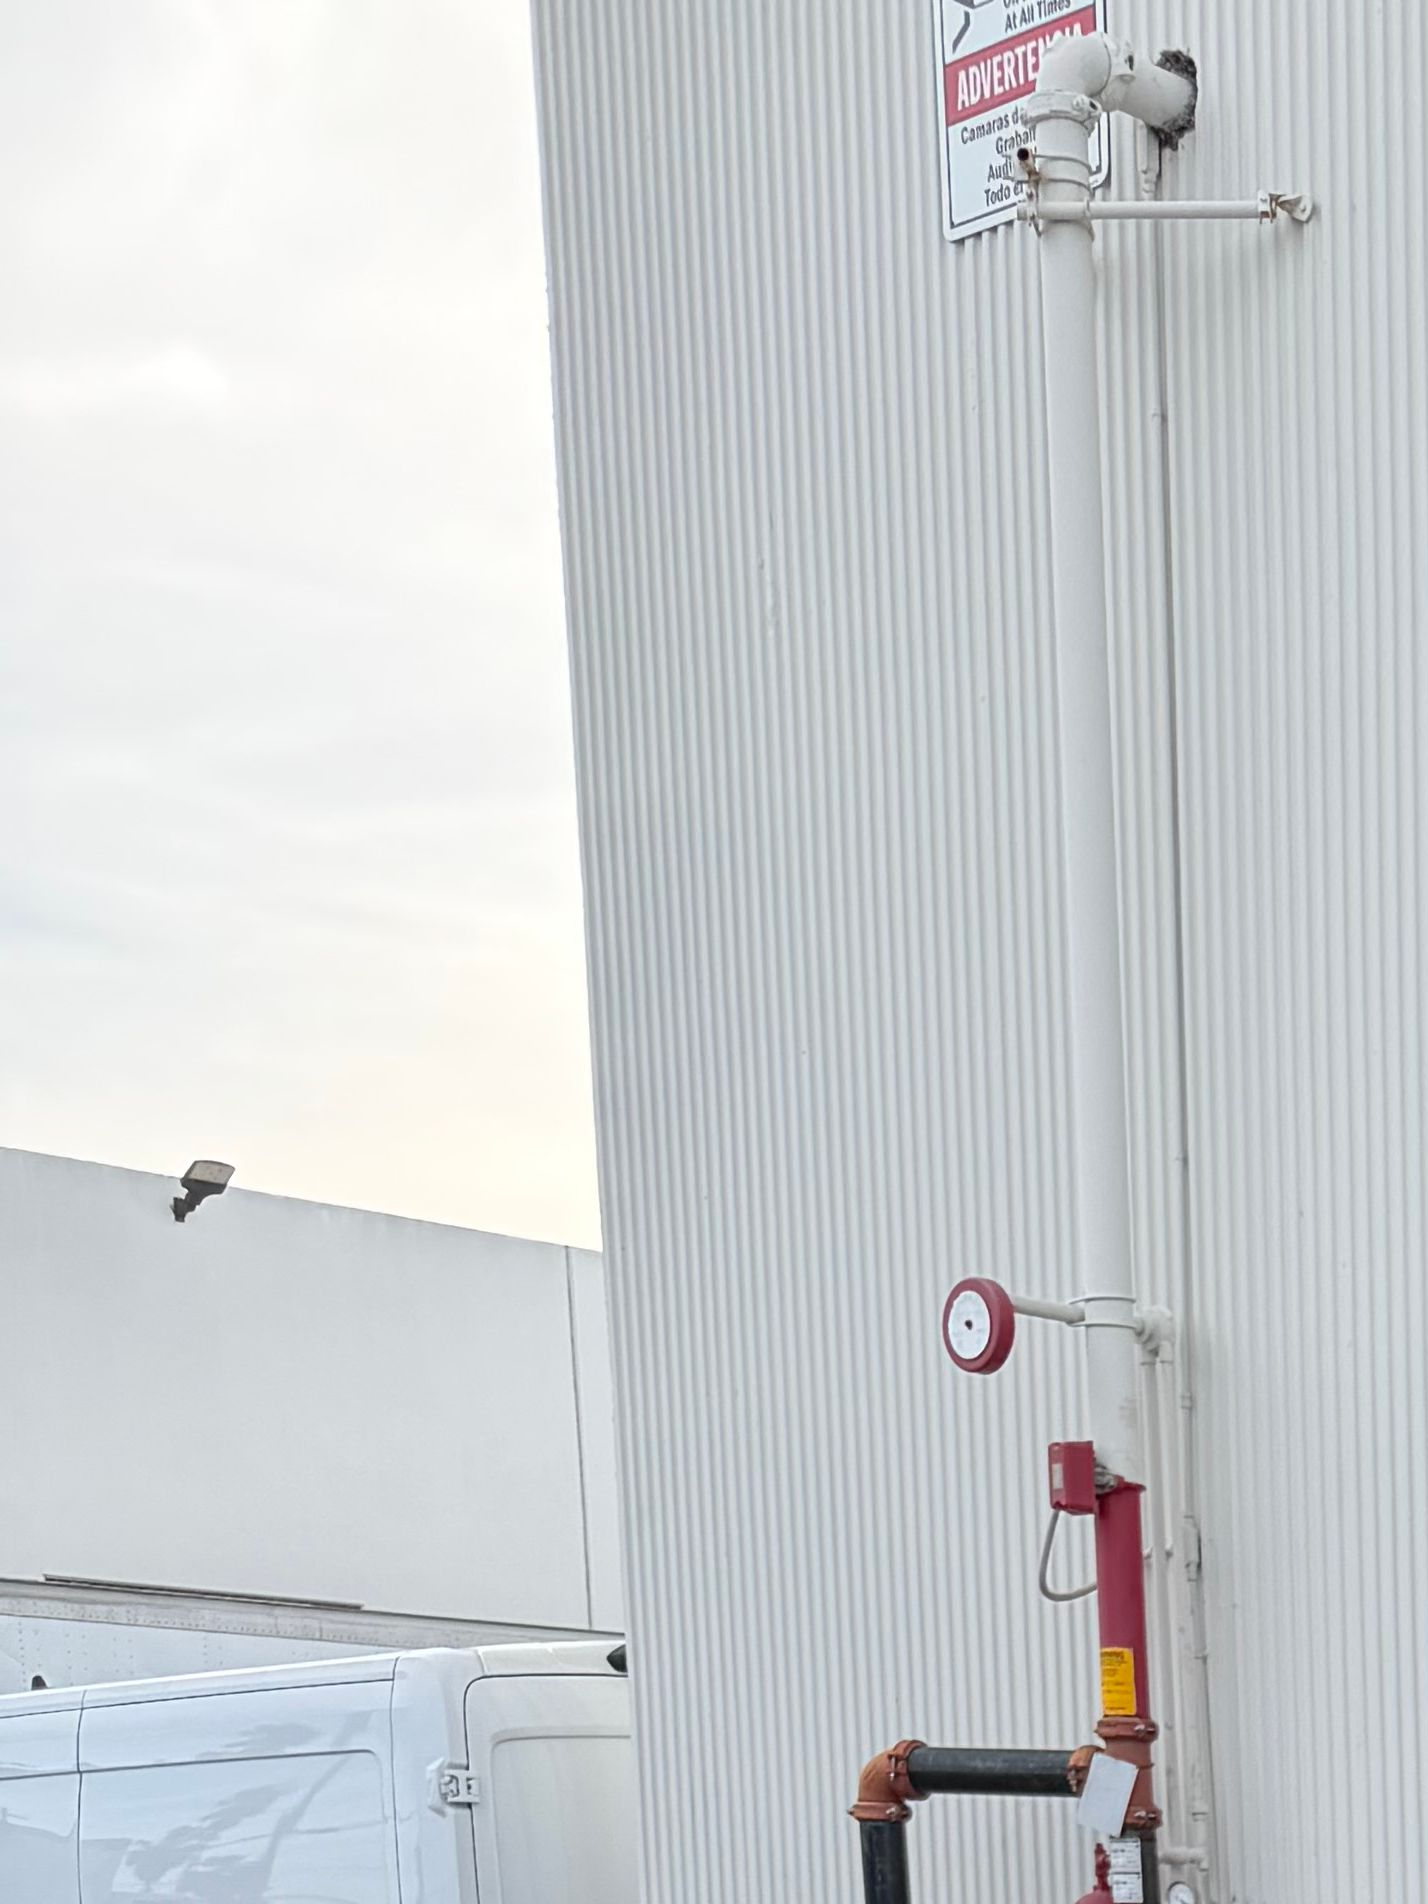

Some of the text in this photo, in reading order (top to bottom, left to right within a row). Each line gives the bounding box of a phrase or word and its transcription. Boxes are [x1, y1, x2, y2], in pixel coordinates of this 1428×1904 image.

[1005, 0, 1071, 34] At All Times
[961, 114, 1010, 144] Camaras
[995, 125, 1036, 154] Graban
[987, 157, 1013, 184] Audi
[984, 183, 1011, 208] Todo
